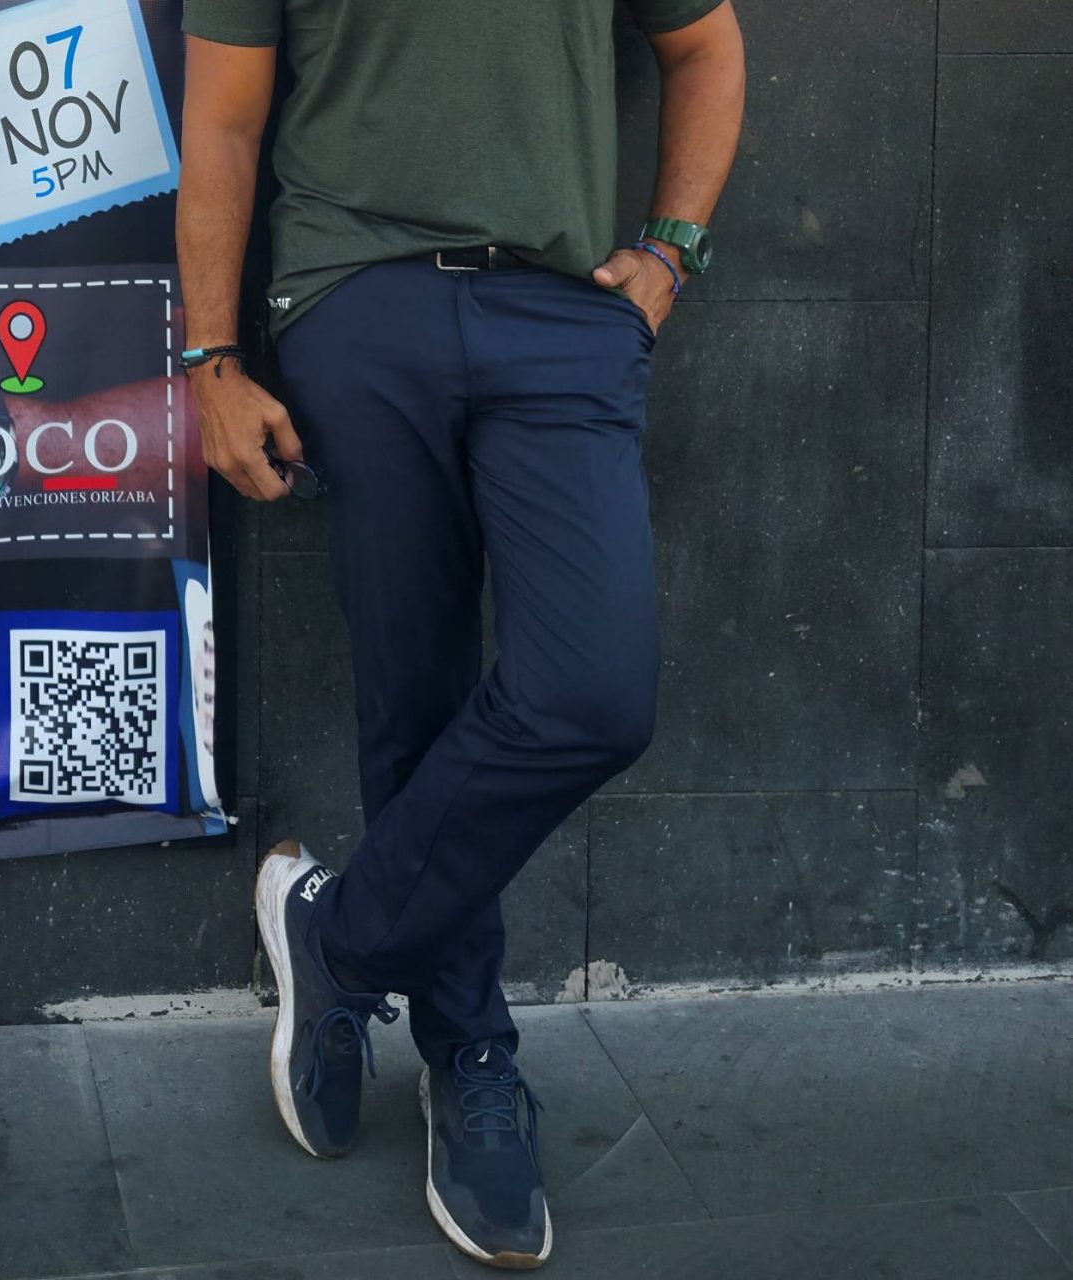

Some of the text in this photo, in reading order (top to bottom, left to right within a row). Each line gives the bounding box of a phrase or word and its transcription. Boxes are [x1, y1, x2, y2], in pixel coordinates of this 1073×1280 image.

[9, 26, 84, 101] 07
[0, 80, 129, 166] NOV
[32, 150, 113, 198] 5PM
[90, 490, 156, 504] ORIZABA
